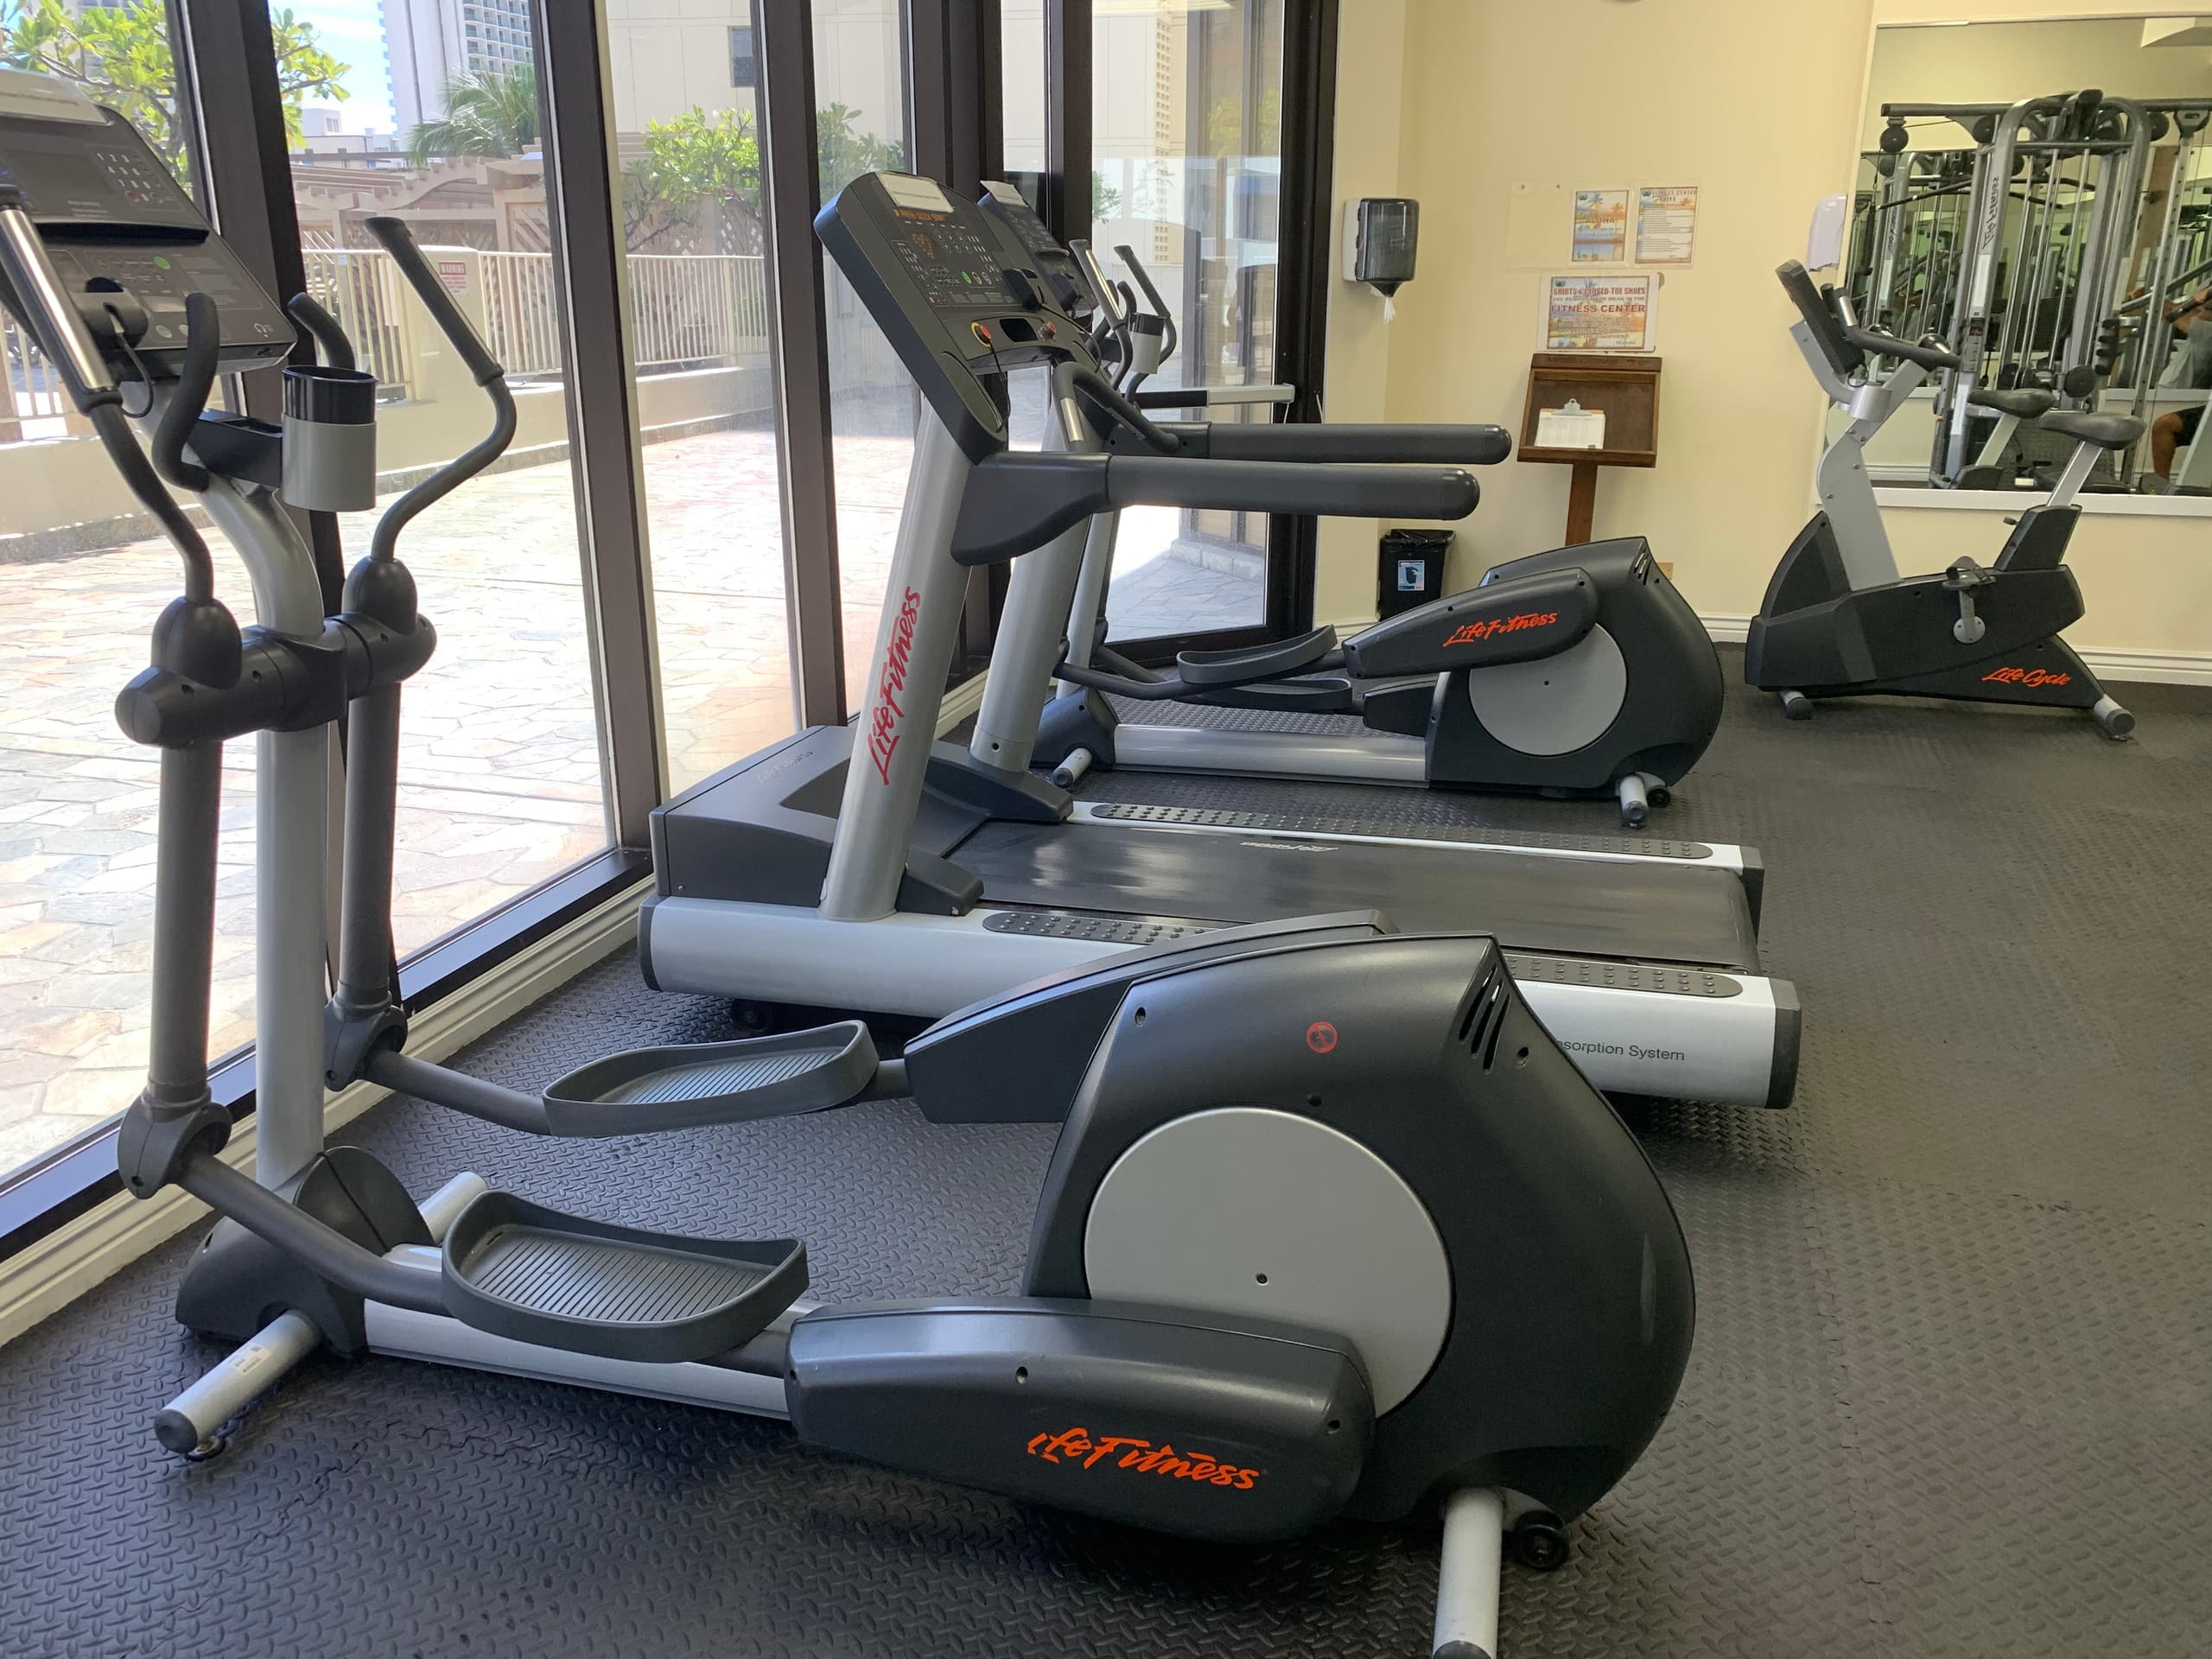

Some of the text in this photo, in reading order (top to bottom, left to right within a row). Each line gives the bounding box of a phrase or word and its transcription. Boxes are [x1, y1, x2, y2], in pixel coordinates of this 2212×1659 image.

[1554, 287, 1577, 296] SHIRTS
[1551, 304, 1646, 313] FITNESS CENTER
[1557, 1039, 1686, 1062] sorption System
